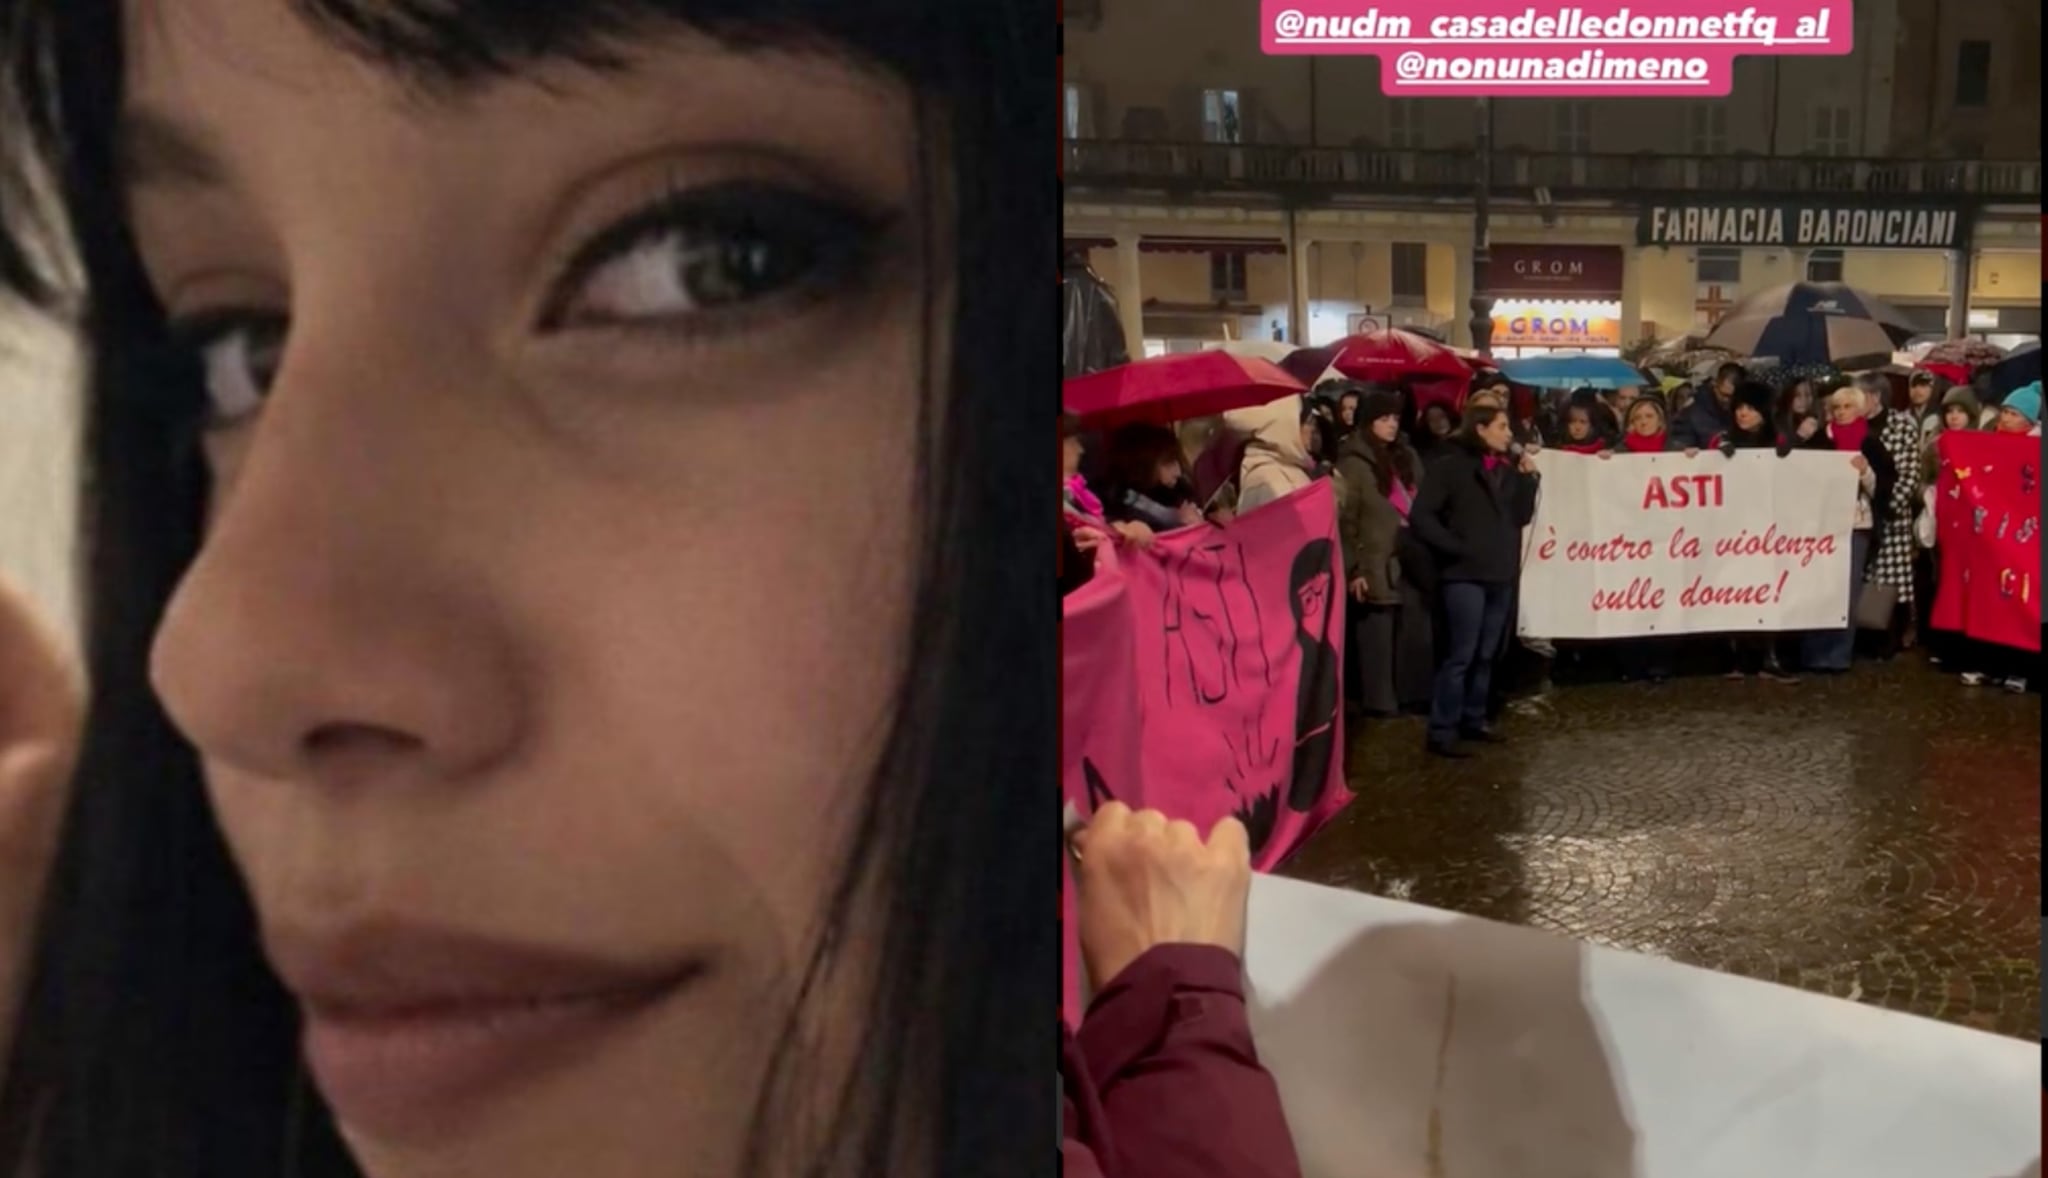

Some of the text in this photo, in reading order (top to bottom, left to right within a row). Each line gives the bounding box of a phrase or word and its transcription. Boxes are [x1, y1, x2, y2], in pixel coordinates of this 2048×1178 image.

[1651, 207, 1957, 245] FARMACIA BARONCIANI
[1513, 260, 1583, 275] GROM
[1510, 317, 1589, 336] GROM
[1643, 474, 1724, 509] ASTI
[1538, 523, 1837, 567] è contro la violenza
[1591, 570, 1789, 611] sulle donne!
